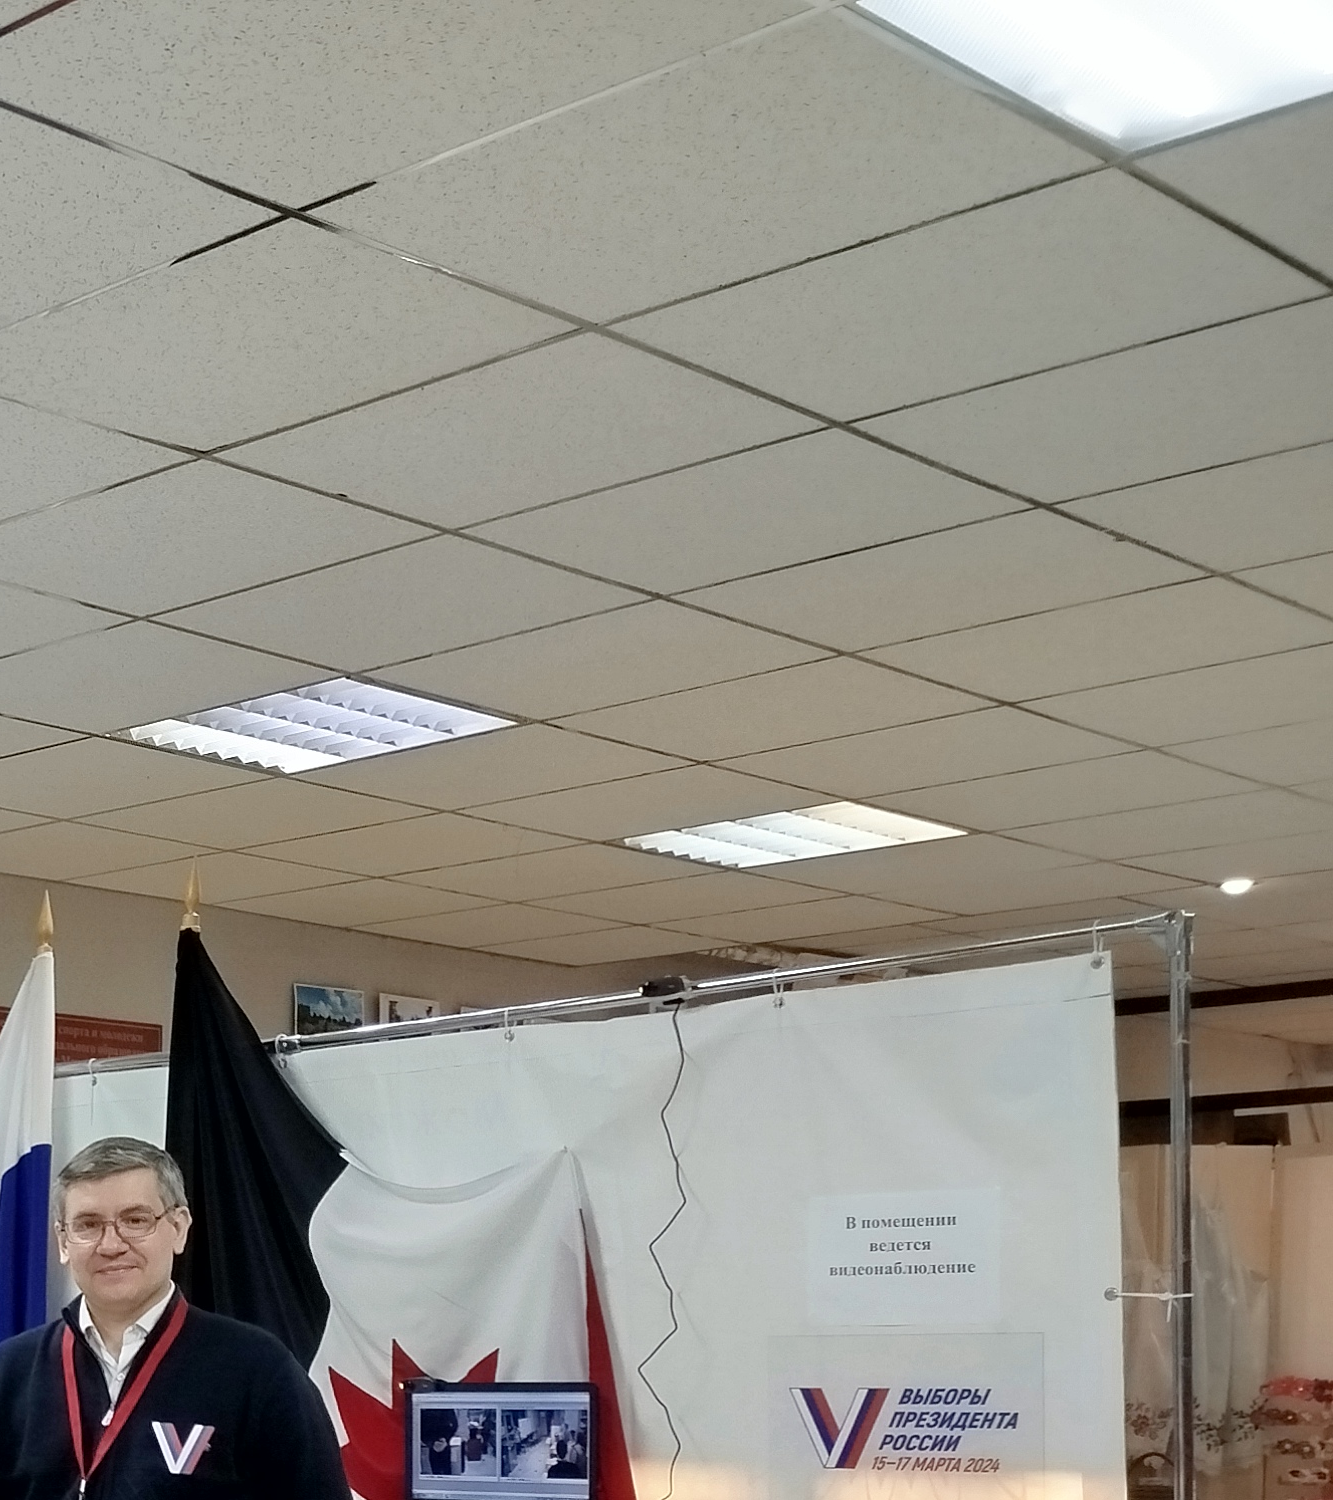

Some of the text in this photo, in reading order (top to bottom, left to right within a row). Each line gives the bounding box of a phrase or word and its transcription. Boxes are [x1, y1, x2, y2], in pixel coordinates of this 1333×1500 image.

[846, 1215, 957, 1230] В помещении
[869, 1240, 932, 1253] ведется
[829, 1261, 977, 1278] видеонаблюдение
[898, 1387, 993, 1406] ВЫБОРЫ
[888, 1410, 1020, 1432] ПРЕЗИДЕНТА
[879, 1433, 963, 1453] РОССИИ
[910, 1456, 963, 1473] МАРТА
[963, 1457, 1001, 1474] 2024
